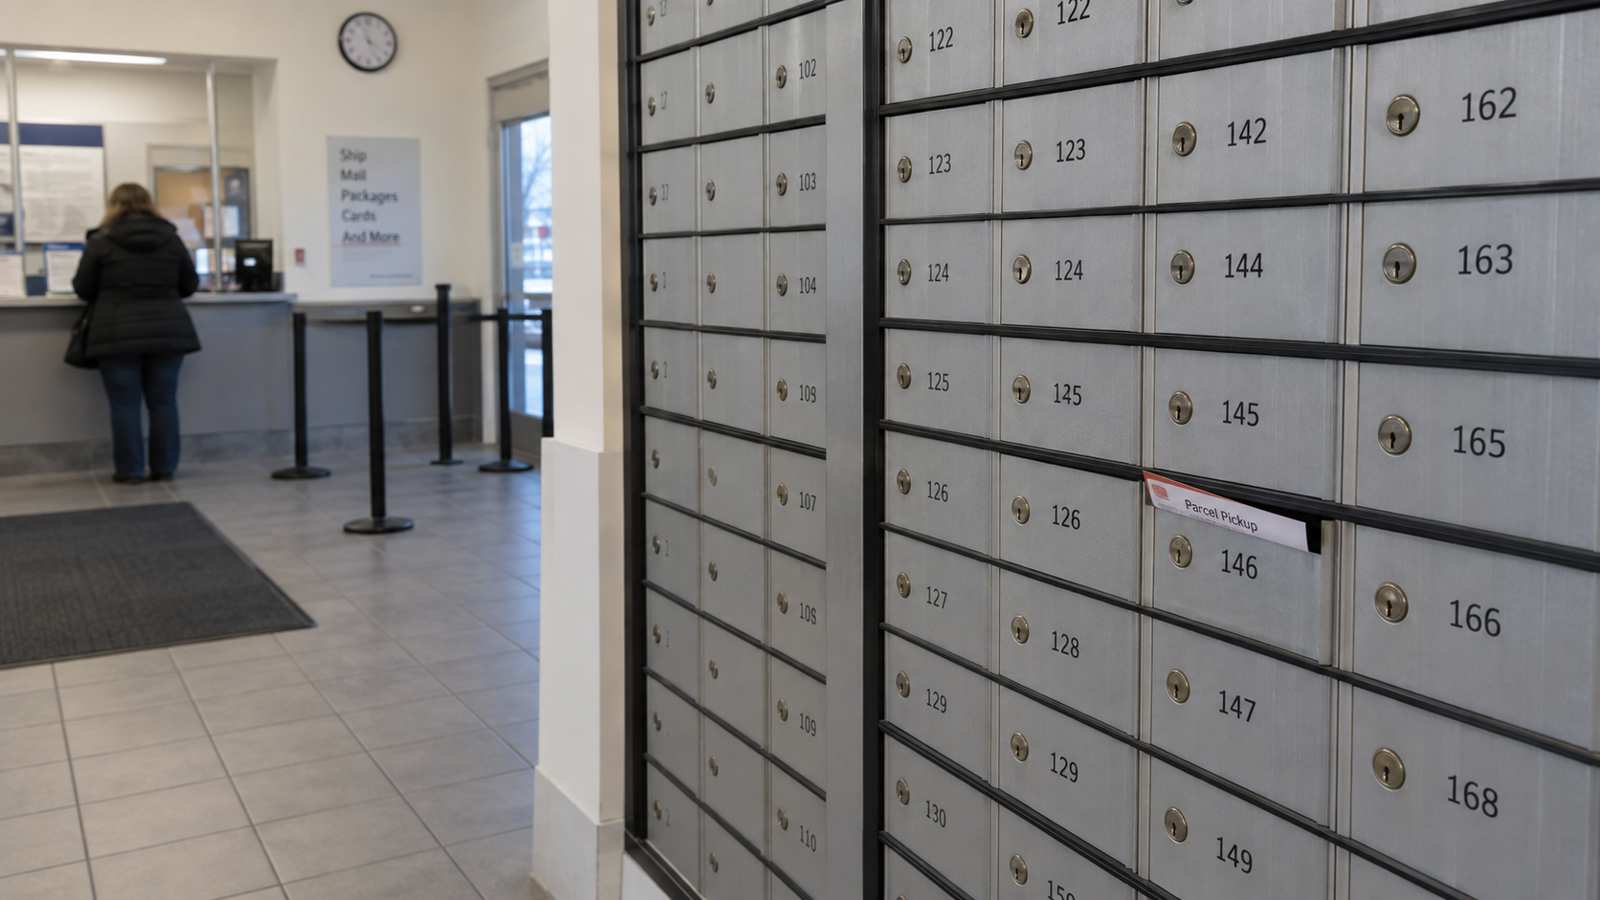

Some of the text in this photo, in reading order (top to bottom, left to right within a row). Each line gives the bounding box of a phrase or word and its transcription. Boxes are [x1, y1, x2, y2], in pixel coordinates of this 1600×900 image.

[1058, 0, 1090, 25] 122
[930, 27, 953, 52] 122
[800, 59, 816, 79] 102
[1462, 87, 1516, 122] 162
[1228, 118, 1266, 146] 142
[340, 148, 367, 163] Ship
[1057, 139, 1085, 162] 123
[340, 169, 367, 181] Mail
[929, 153, 951, 174] 123
[800, 172, 816, 191] 103
[341, 189, 398, 205] Packages
[342, 210, 376, 221] Cards
[342, 231, 400, 243] And More
[1056, 260, 1083, 280] 124
[1225, 253, 1263, 278] 144
[1459, 244, 1512, 275] 163
[928, 263, 949, 282] 124
[800, 277, 816, 294] 104
[928, 372, 949, 391] 125
[1223, 400, 1259, 426] 145
[1454, 425, 1505, 458] 165
[800, 492, 816, 511] 107
[928, 481, 948, 502] 126
[1053, 505, 1080, 530] 126
[1184, 499, 1258, 532] Parcel Pickup
[1222, 550, 1257, 579] 146
[927, 586, 947, 608] 127
[1450, 600, 1500, 637] 166
[1052, 631, 1079, 658] 128
[927, 689, 947, 713] 129
[1219, 690, 1256, 722] 147
[800, 713, 816, 736] 109
[1050, 752, 1078, 783] 129
[1448, 775, 1498, 818] 168
[926, 800, 946, 828] 130
[800, 825, 816, 852] 110
[1217, 837, 1252, 874] 149
